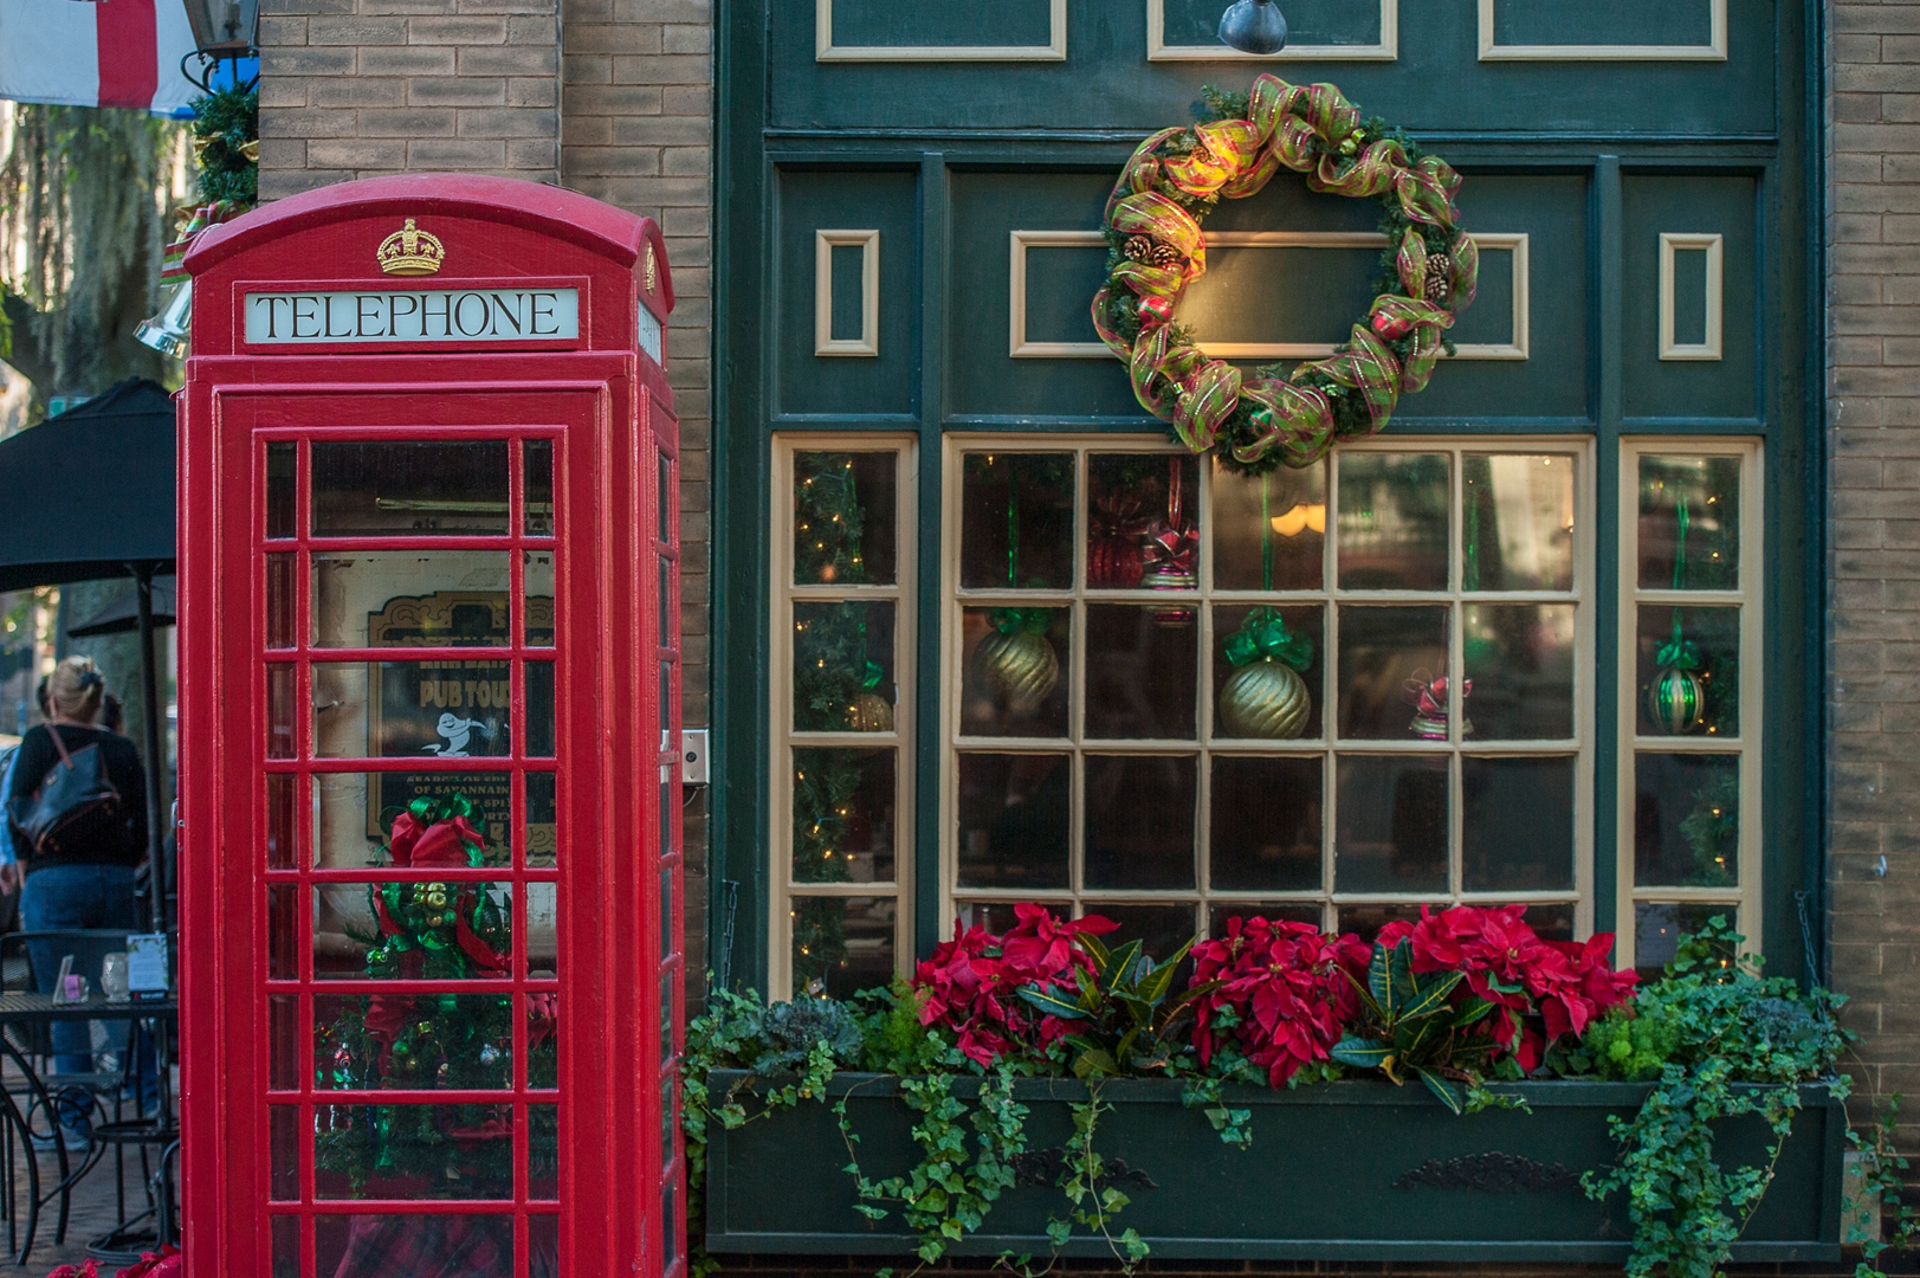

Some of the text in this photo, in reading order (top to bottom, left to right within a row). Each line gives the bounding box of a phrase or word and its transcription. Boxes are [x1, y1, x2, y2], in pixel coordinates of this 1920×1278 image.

[255, 292, 560, 339] TELEPHONE
[419, 680, 511, 708] PUB TOU
